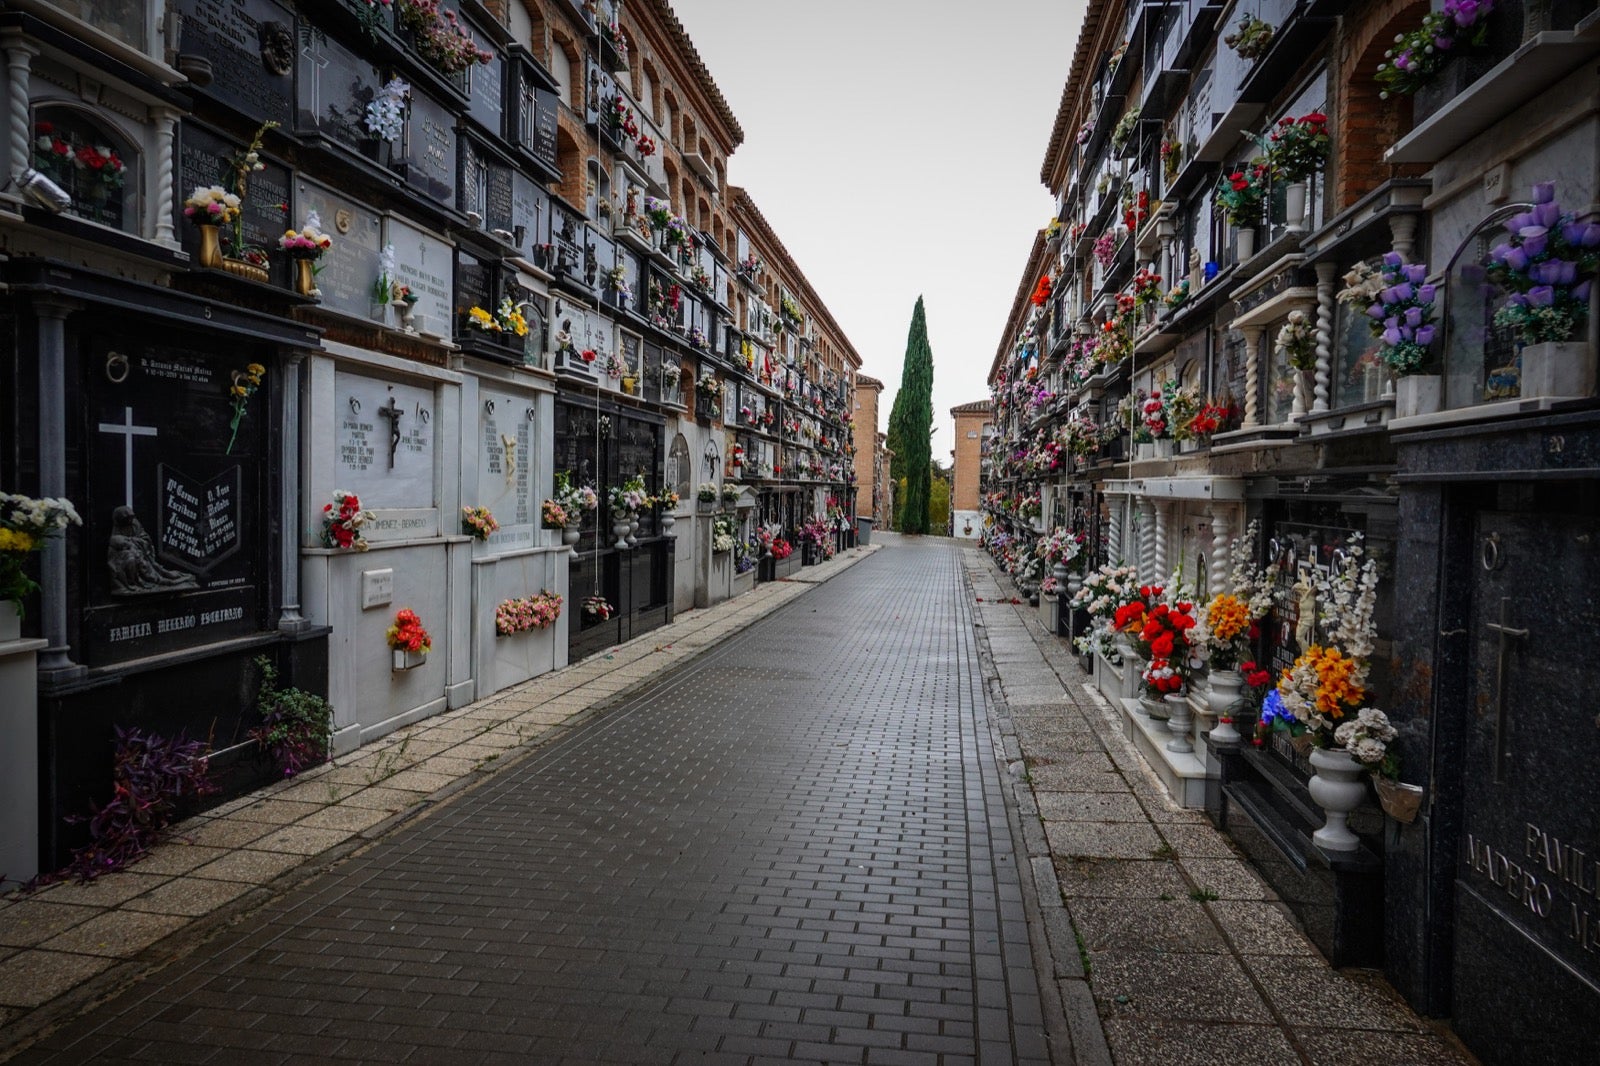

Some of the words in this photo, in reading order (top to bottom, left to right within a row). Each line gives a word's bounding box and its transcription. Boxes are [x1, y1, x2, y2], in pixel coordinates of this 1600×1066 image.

[185, 159, 219, 179] DOLORES
[194, 149, 220, 170] MARIA
[204, 305, 212, 319] 5
[1549, 435, 1565, 453] 20
[176, 484, 199, 506] Carmen
[167, 494, 197, 520] Escribano
[109, 622, 152, 642] FAMILIA
[157, 614, 196, 634] MELLADO
[200, 606, 243, 626] ESCRIBANO
[1465, 832, 1552, 919] MADERO
